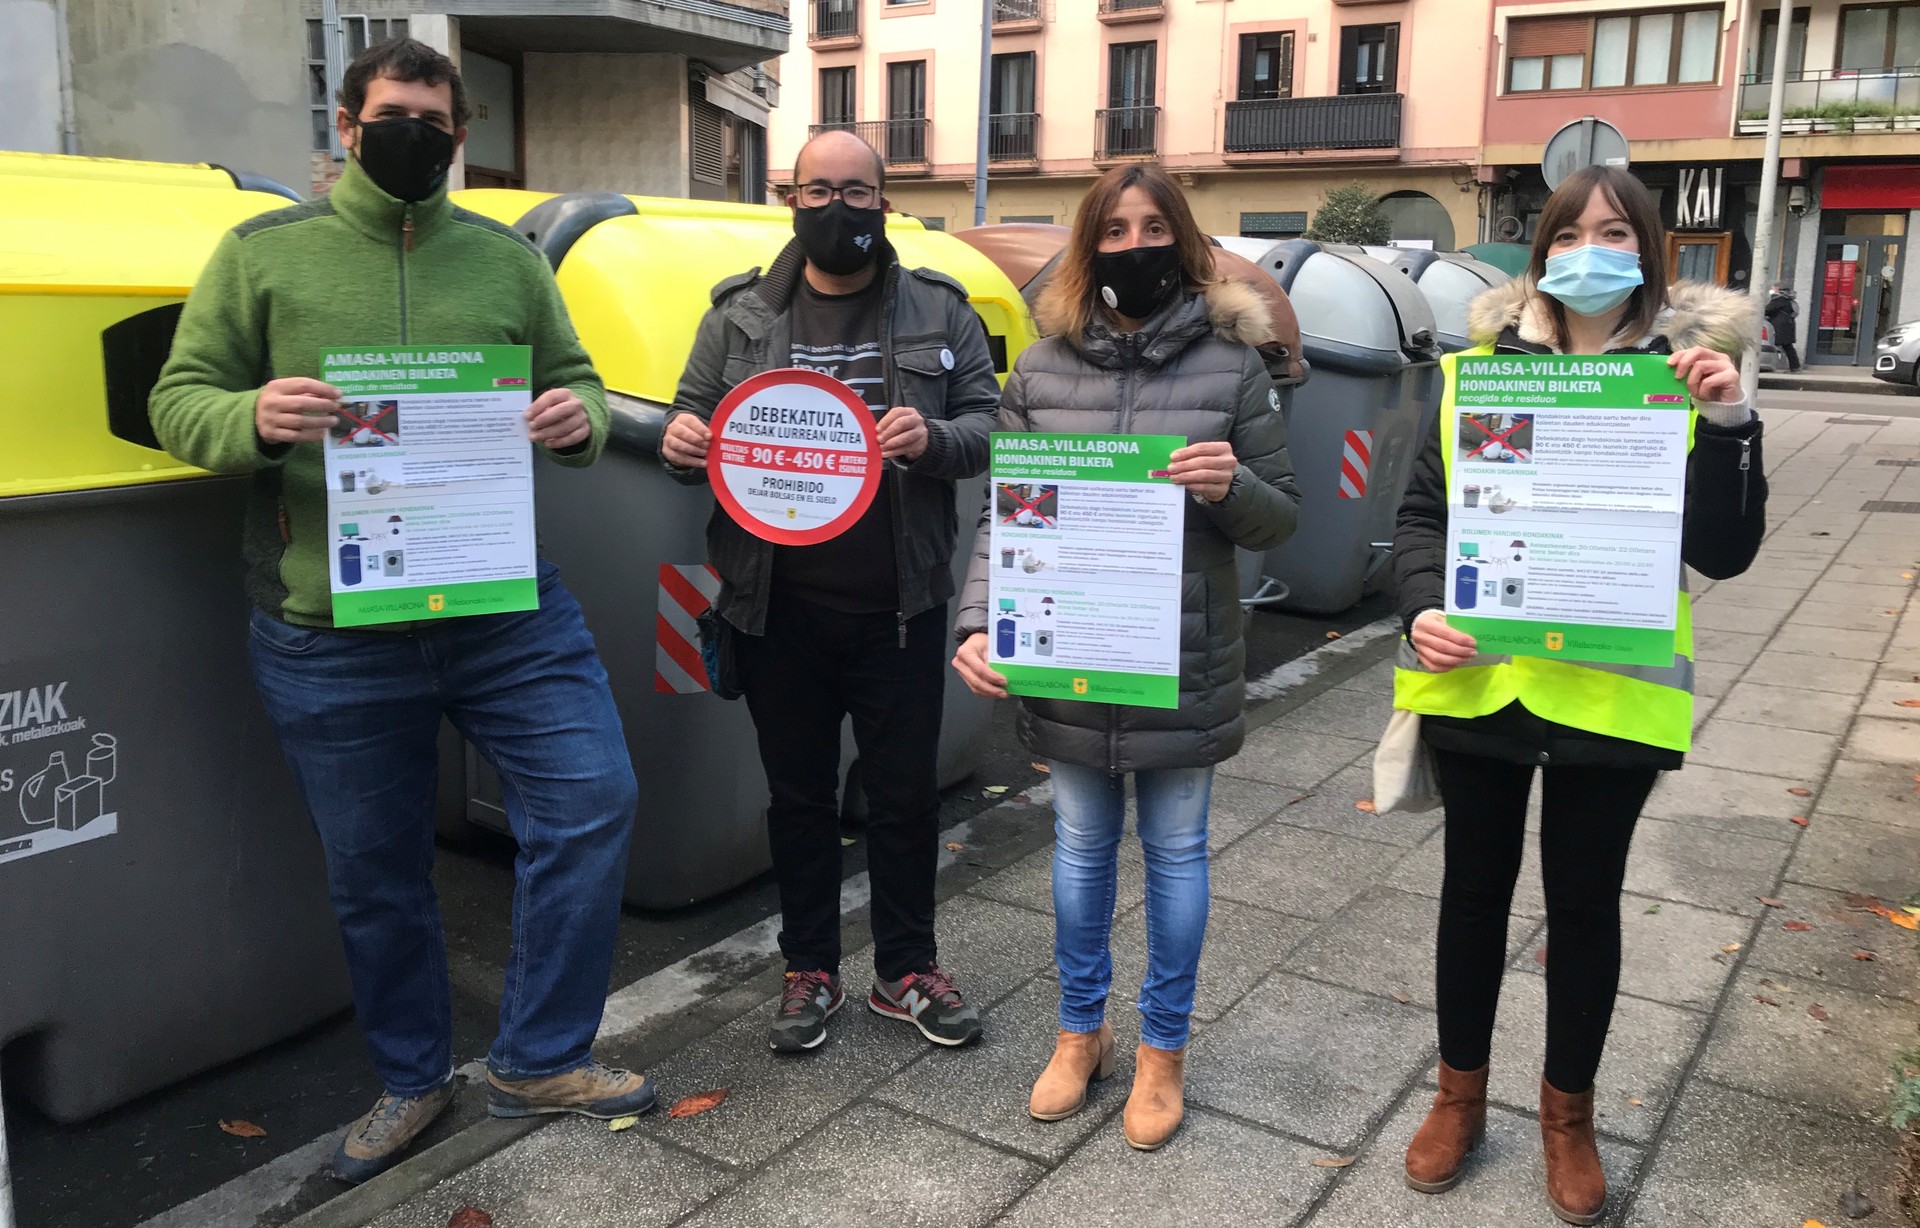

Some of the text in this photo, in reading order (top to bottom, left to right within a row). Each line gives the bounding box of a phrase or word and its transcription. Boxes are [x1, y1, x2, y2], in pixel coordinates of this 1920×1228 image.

[1676, 168, 1724, 228] KAI
[324, 352, 484, 366] AMASA-VILLABONA
[326, 368, 458, 382] HONDAKINEN BILKETA
[1460, 362, 1633, 376] AMASA-VILLABONA
[1460, 380, 1602, 393] HONDAKINEN BILKETA
[1459, 395, 1500, 403] recogida
[750, 406, 843, 428] DEBEKATUTA
[729, 422, 862, 444] POLTSAK LURREAN UZTEA
[995, 439, 1139, 454] AMASA-VILLABONA
[995, 454, 1114, 468] HONDAKINEN BILKETA
[762, 477, 824, 493] PROHIBIDO
[748, 488, 768, 497] DEJAR
[770, 491, 794, 500] BOLSAS
[1474, 634, 1542, 645] ASA-VILLABONA
[12, 716, 85, 744] metalezkoak
